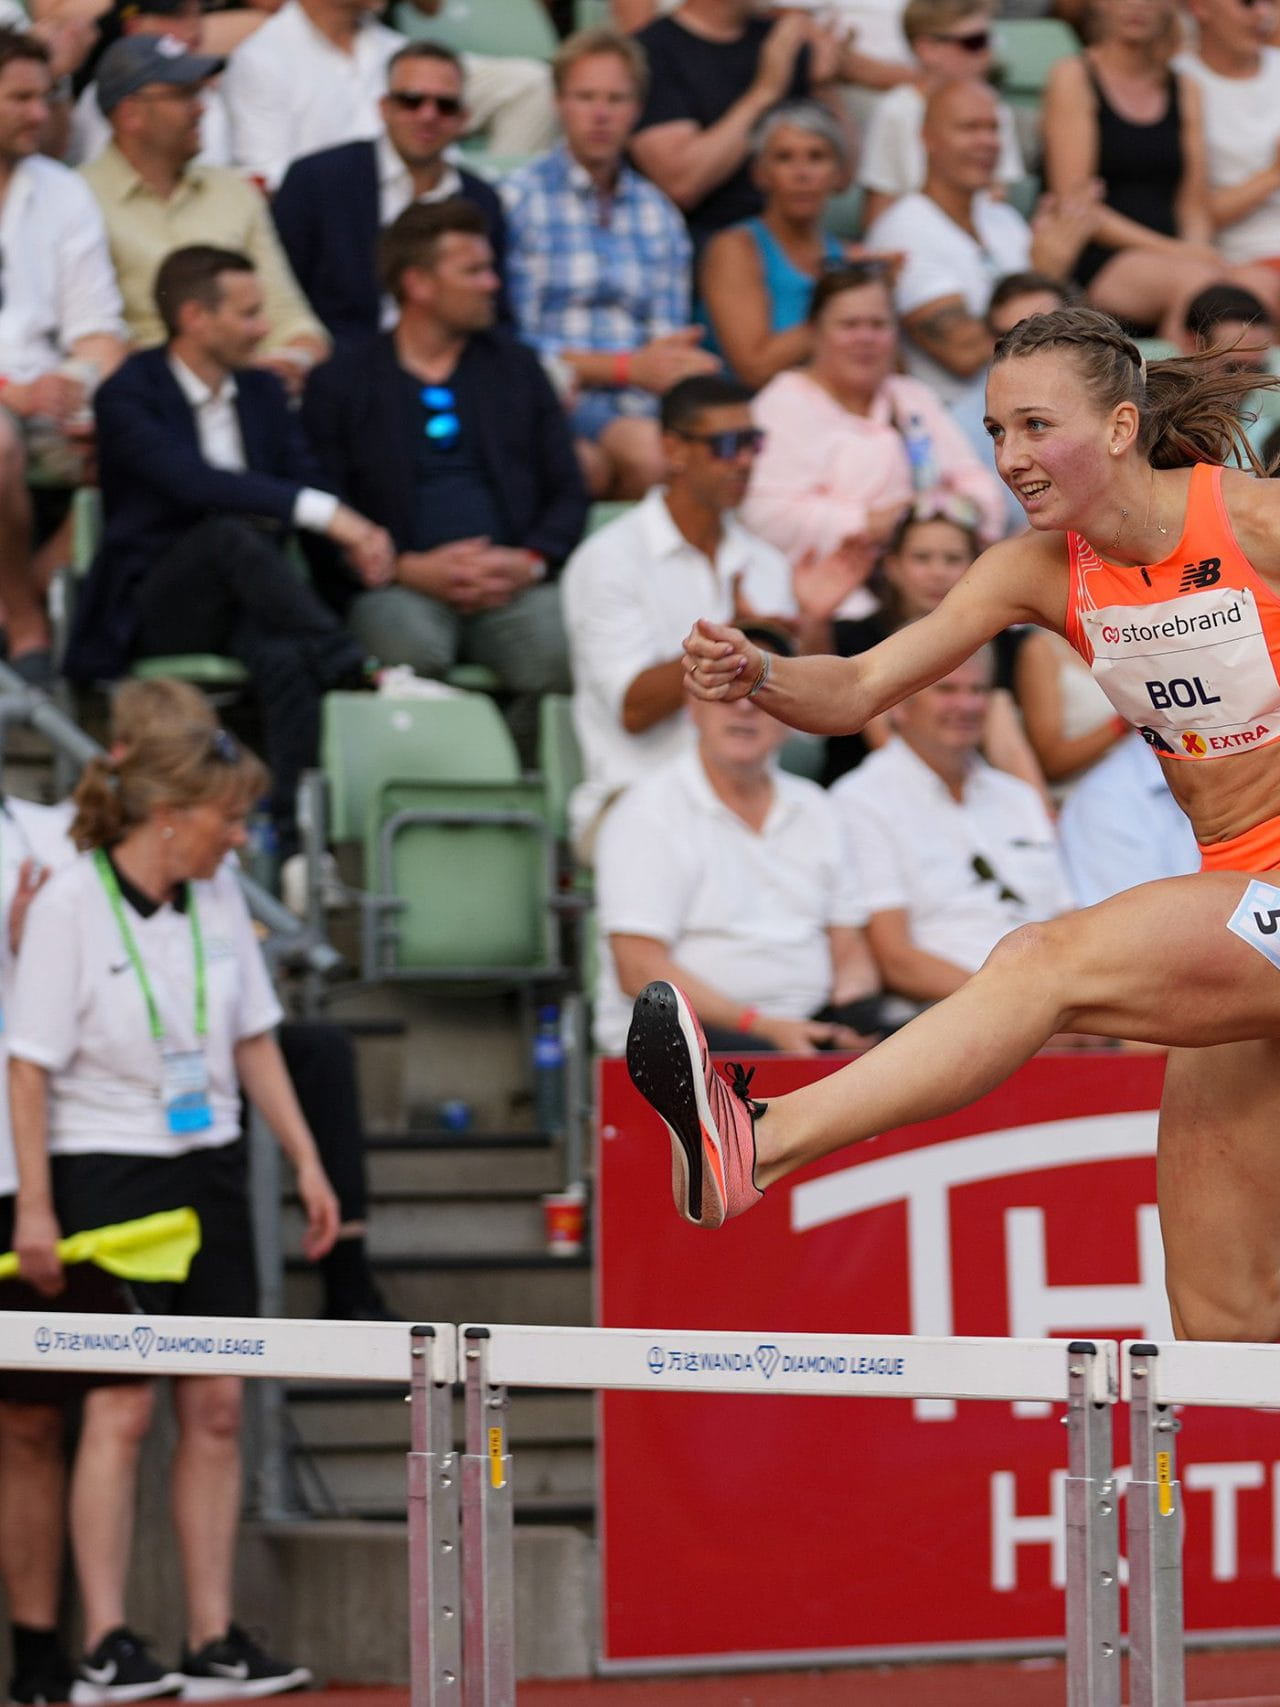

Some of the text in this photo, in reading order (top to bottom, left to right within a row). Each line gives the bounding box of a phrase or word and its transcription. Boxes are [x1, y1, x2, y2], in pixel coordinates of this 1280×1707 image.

[1121, 603, 1242, 643] storebrand
[1145, 676, 1221, 710] BOL
[1209, 724, 1270, 750] EXTRA
[156, 1337, 214, 1355] DIAMOND
[218, 1339, 266, 1356] LEAGUE
[700, 1353, 752, 1372] WANDA
[783, 1355, 847, 1375] DIAMOND
[850, 1356, 905, 1376] LEAGUE
